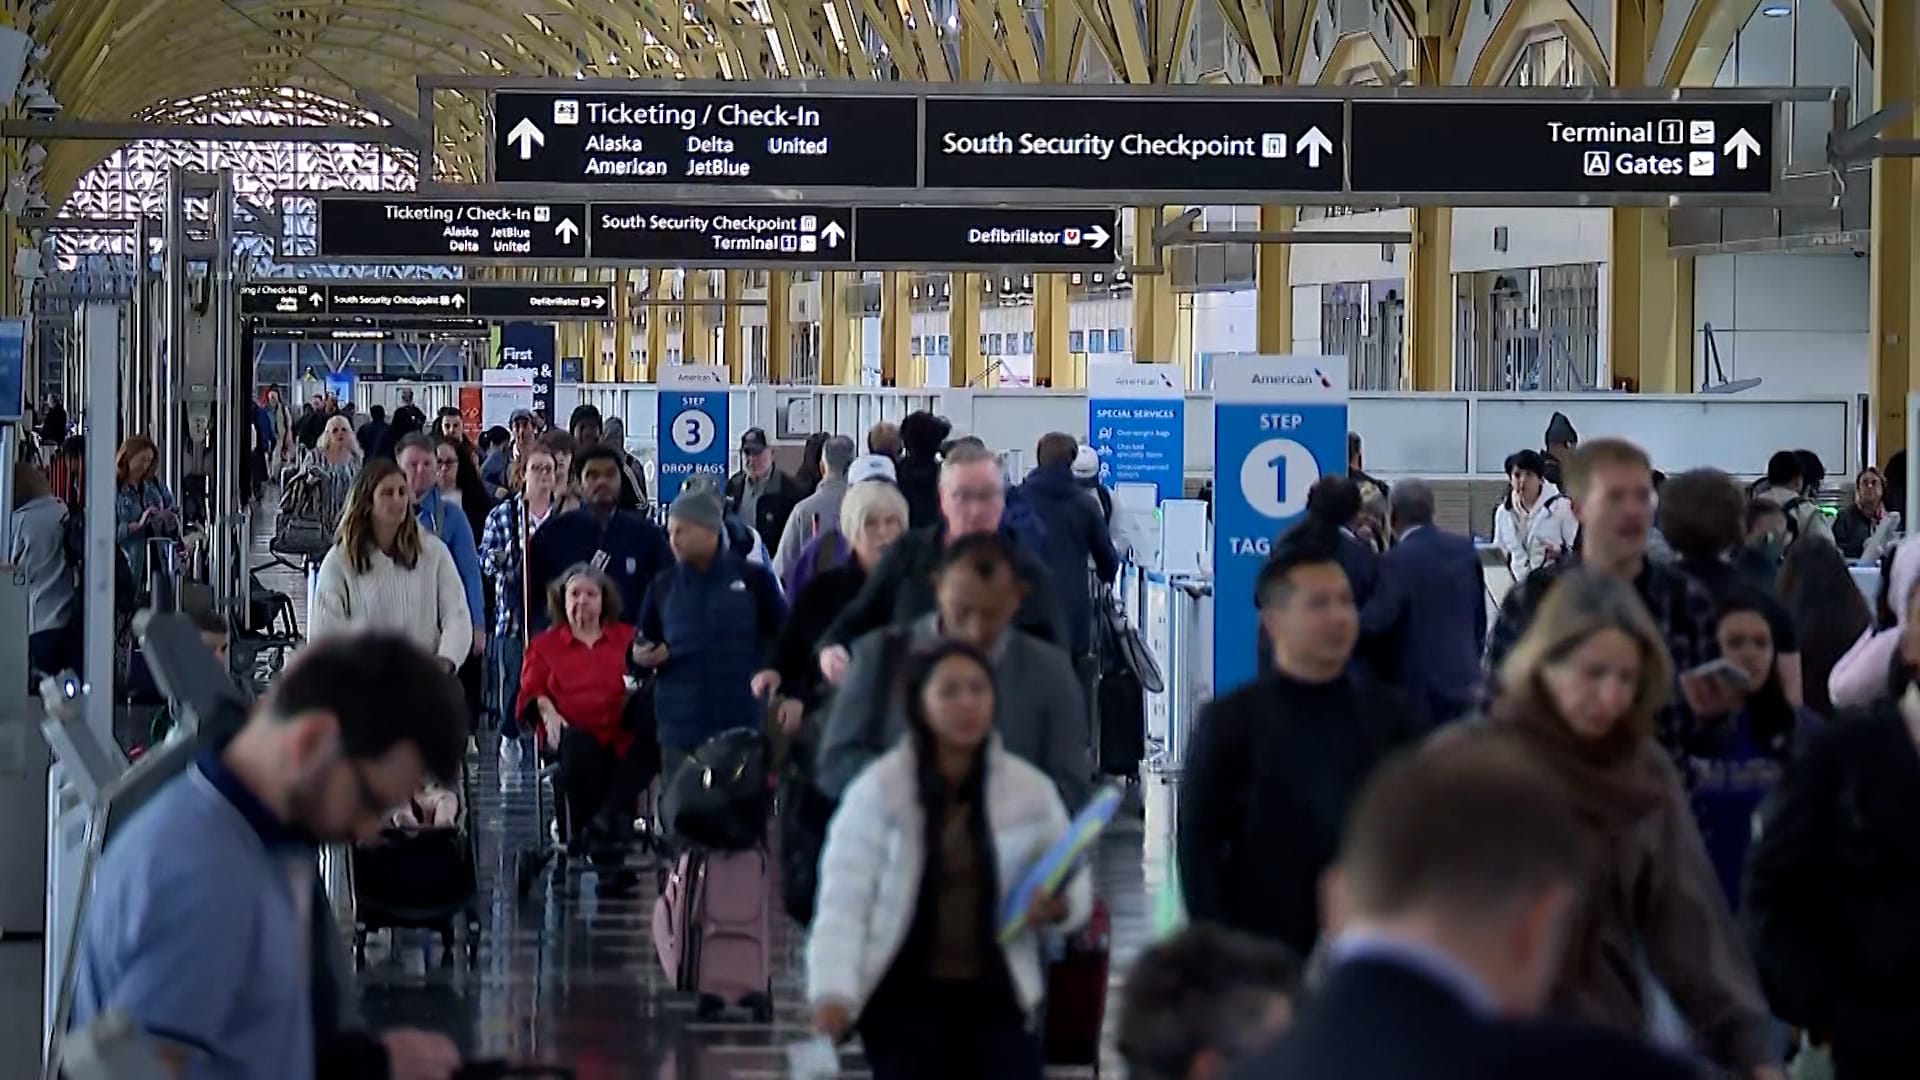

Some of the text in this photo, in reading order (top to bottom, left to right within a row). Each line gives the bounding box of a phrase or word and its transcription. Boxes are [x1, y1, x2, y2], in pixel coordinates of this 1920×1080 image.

[585, 101, 820, 130] Ticketing / Check-In
[1546, 121, 1653, 143] Terminal
[585, 133, 643, 152] Alaska
[687, 135, 734, 154] Delta
[767, 137, 828, 155] United
[942, 131, 1256, 160] South Security Checkpoint
[583, 157, 668, 176] American
[685, 157, 751, 177] JetBlue
[1588, 152, 1684, 175] A Gates
[383, 205, 531, 224] Ticketing / Check-In
[442, 225, 480, 238] Alaska
[490, 226, 531, 239] JetBlue
[601, 214, 797, 234] South Security Checkpoint
[711, 234, 779, 251] Terminal
[968, 227, 1061, 244] Defibrillator
[449, 239, 480, 252] Delta
[493, 239, 531, 253] United
[333, 295, 440, 306] South Security Checkpoint
[529, 296, 580, 306] Defibrillator
[503, 346, 533, 361] First
[540, 363, 553, 378] &
[1251, 373, 1313, 385] American
[682, 397, 705, 406] STEP
[1096, 409, 1174, 419] SPECIAL SERVICES
[1259, 413, 1303, 430] STEP
[685, 418, 701, 446] 3
[661, 463, 725, 475] DROP BAGS
[1267, 454, 1287, 503] 1
[1229, 536, 1271, 556] TAG
